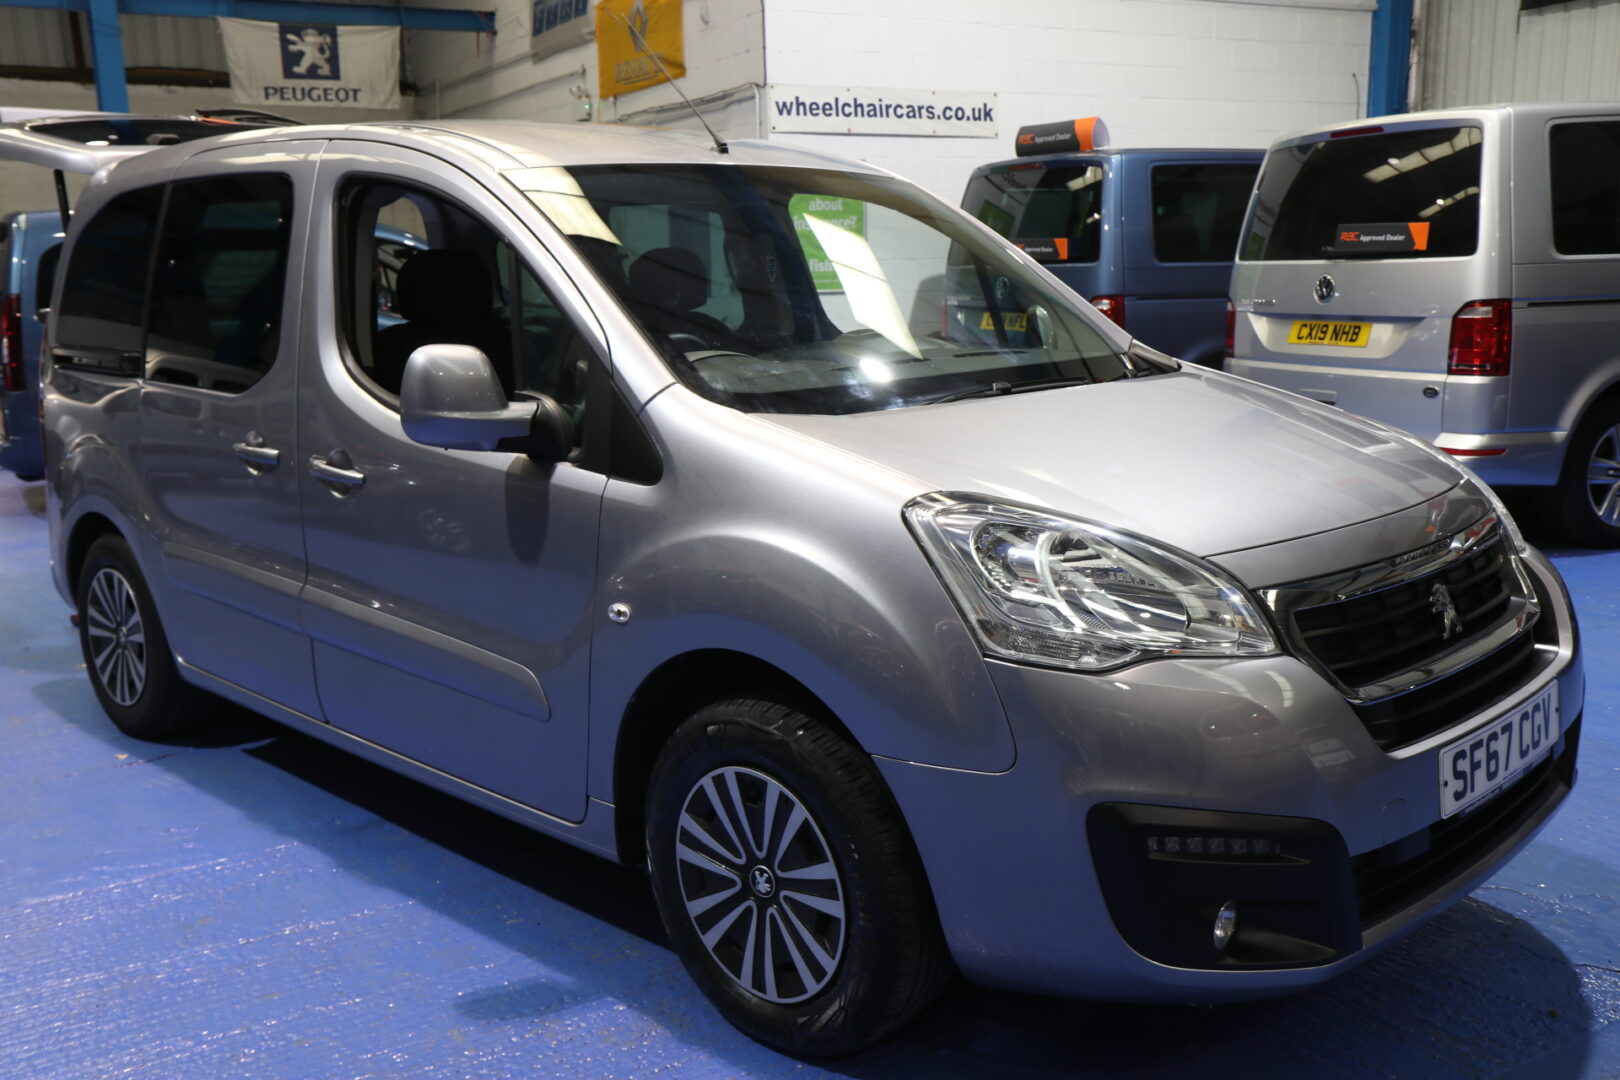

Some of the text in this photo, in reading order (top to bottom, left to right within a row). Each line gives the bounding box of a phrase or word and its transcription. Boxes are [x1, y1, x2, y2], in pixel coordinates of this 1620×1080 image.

[264, 86, 361, 102] PEUGEOT
[775, 96, 994, 122] wheelchaircars.co.uk
[808, 198, 843, 211] about
[1360, 234, 1385, 242] Approved
[1296, 323, 1362, 343] CX19 NHB
[1452, 726, 1514, 802] SF67
[1518, 694, 1552, 761] CGV
